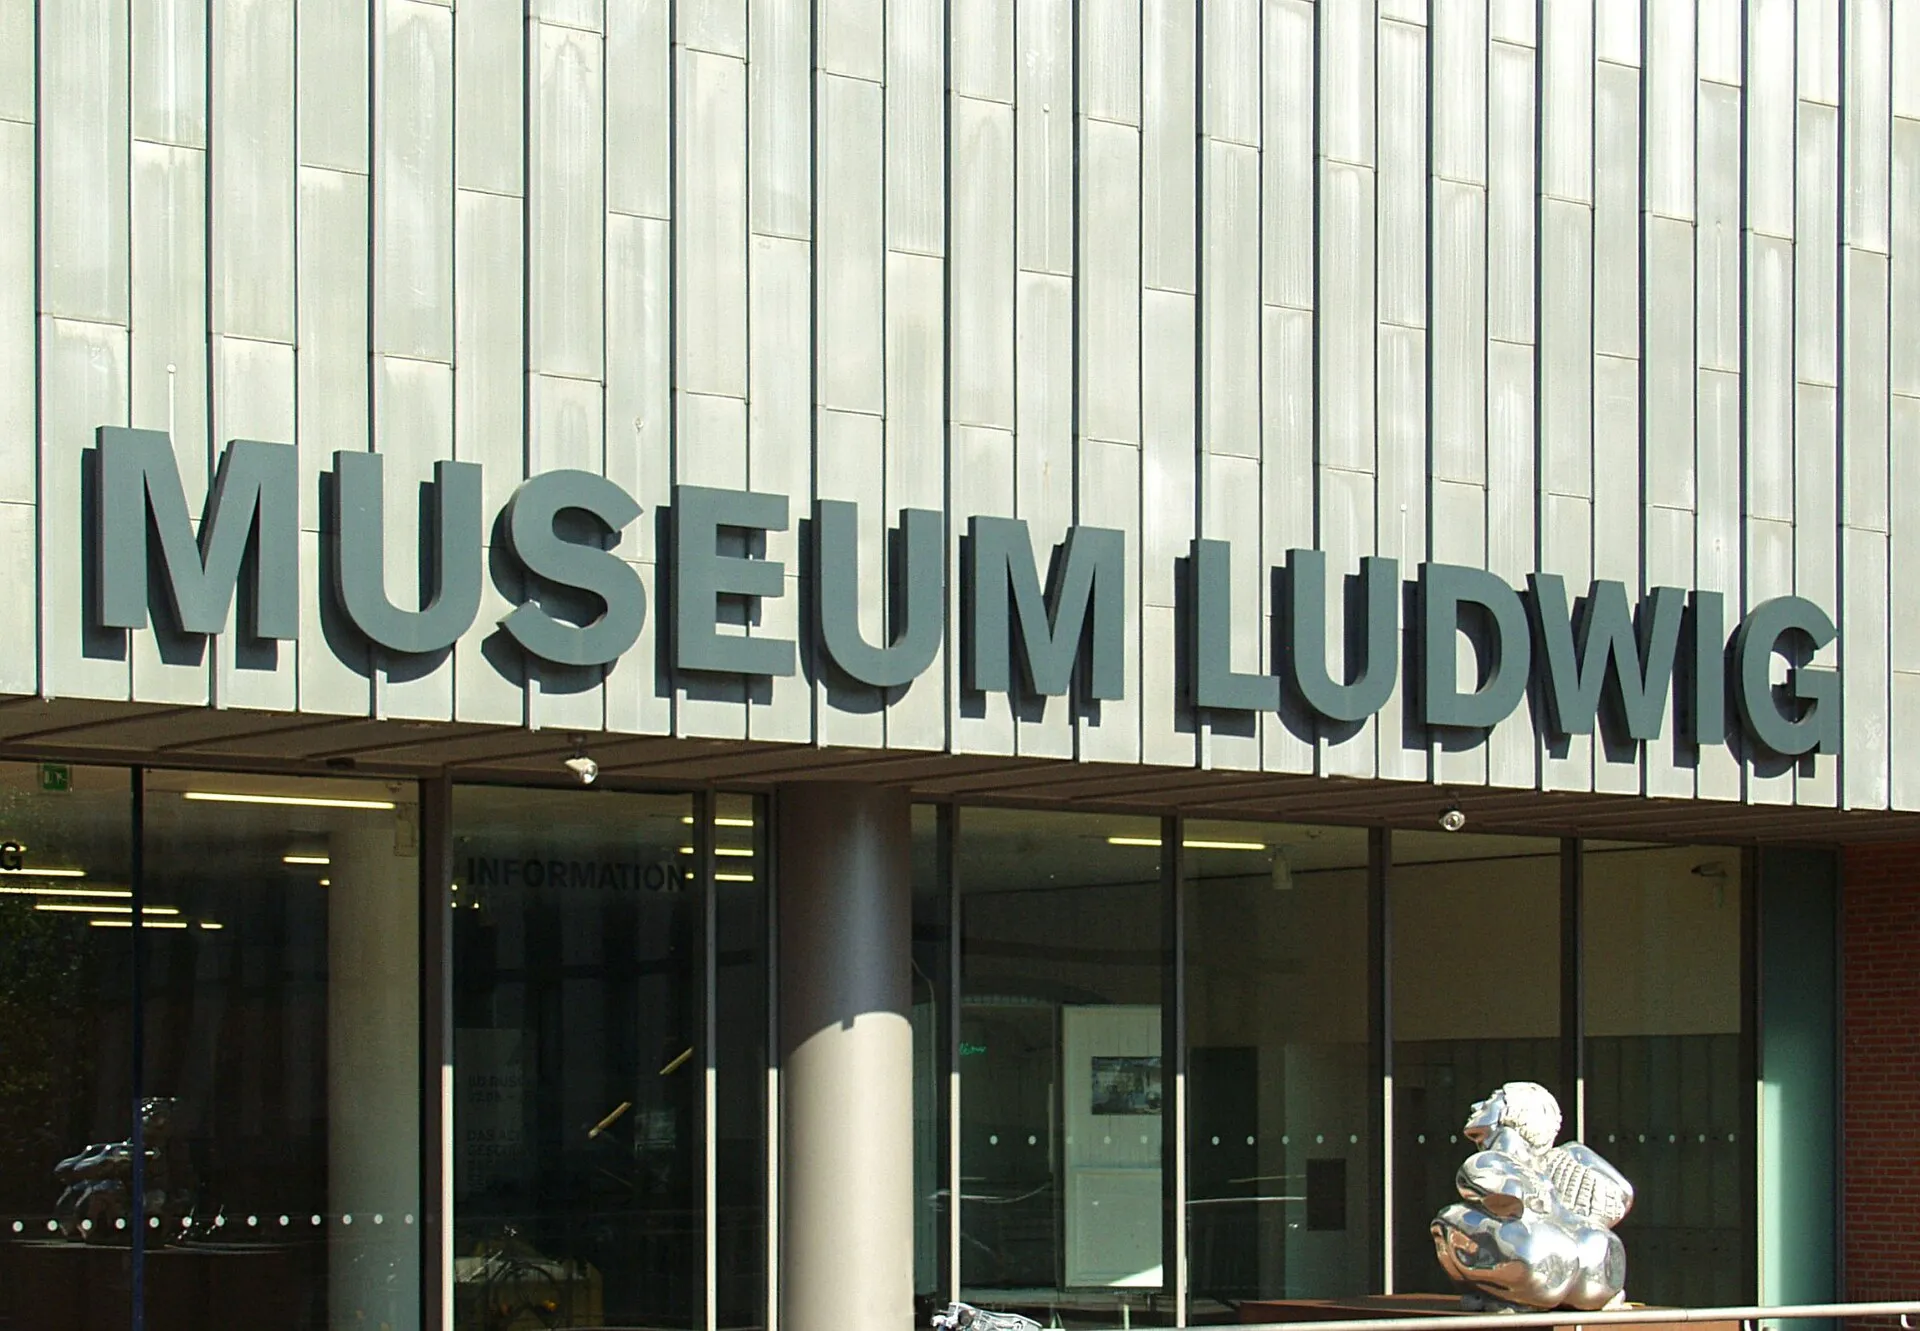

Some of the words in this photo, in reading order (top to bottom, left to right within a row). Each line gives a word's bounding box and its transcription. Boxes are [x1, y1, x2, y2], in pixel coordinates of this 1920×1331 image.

[95, 425, 1125, 702] MUSEUM
[1189, 537, 1840, 756] LUDWIG
[467, 857, 686, 892] INFORMATION
